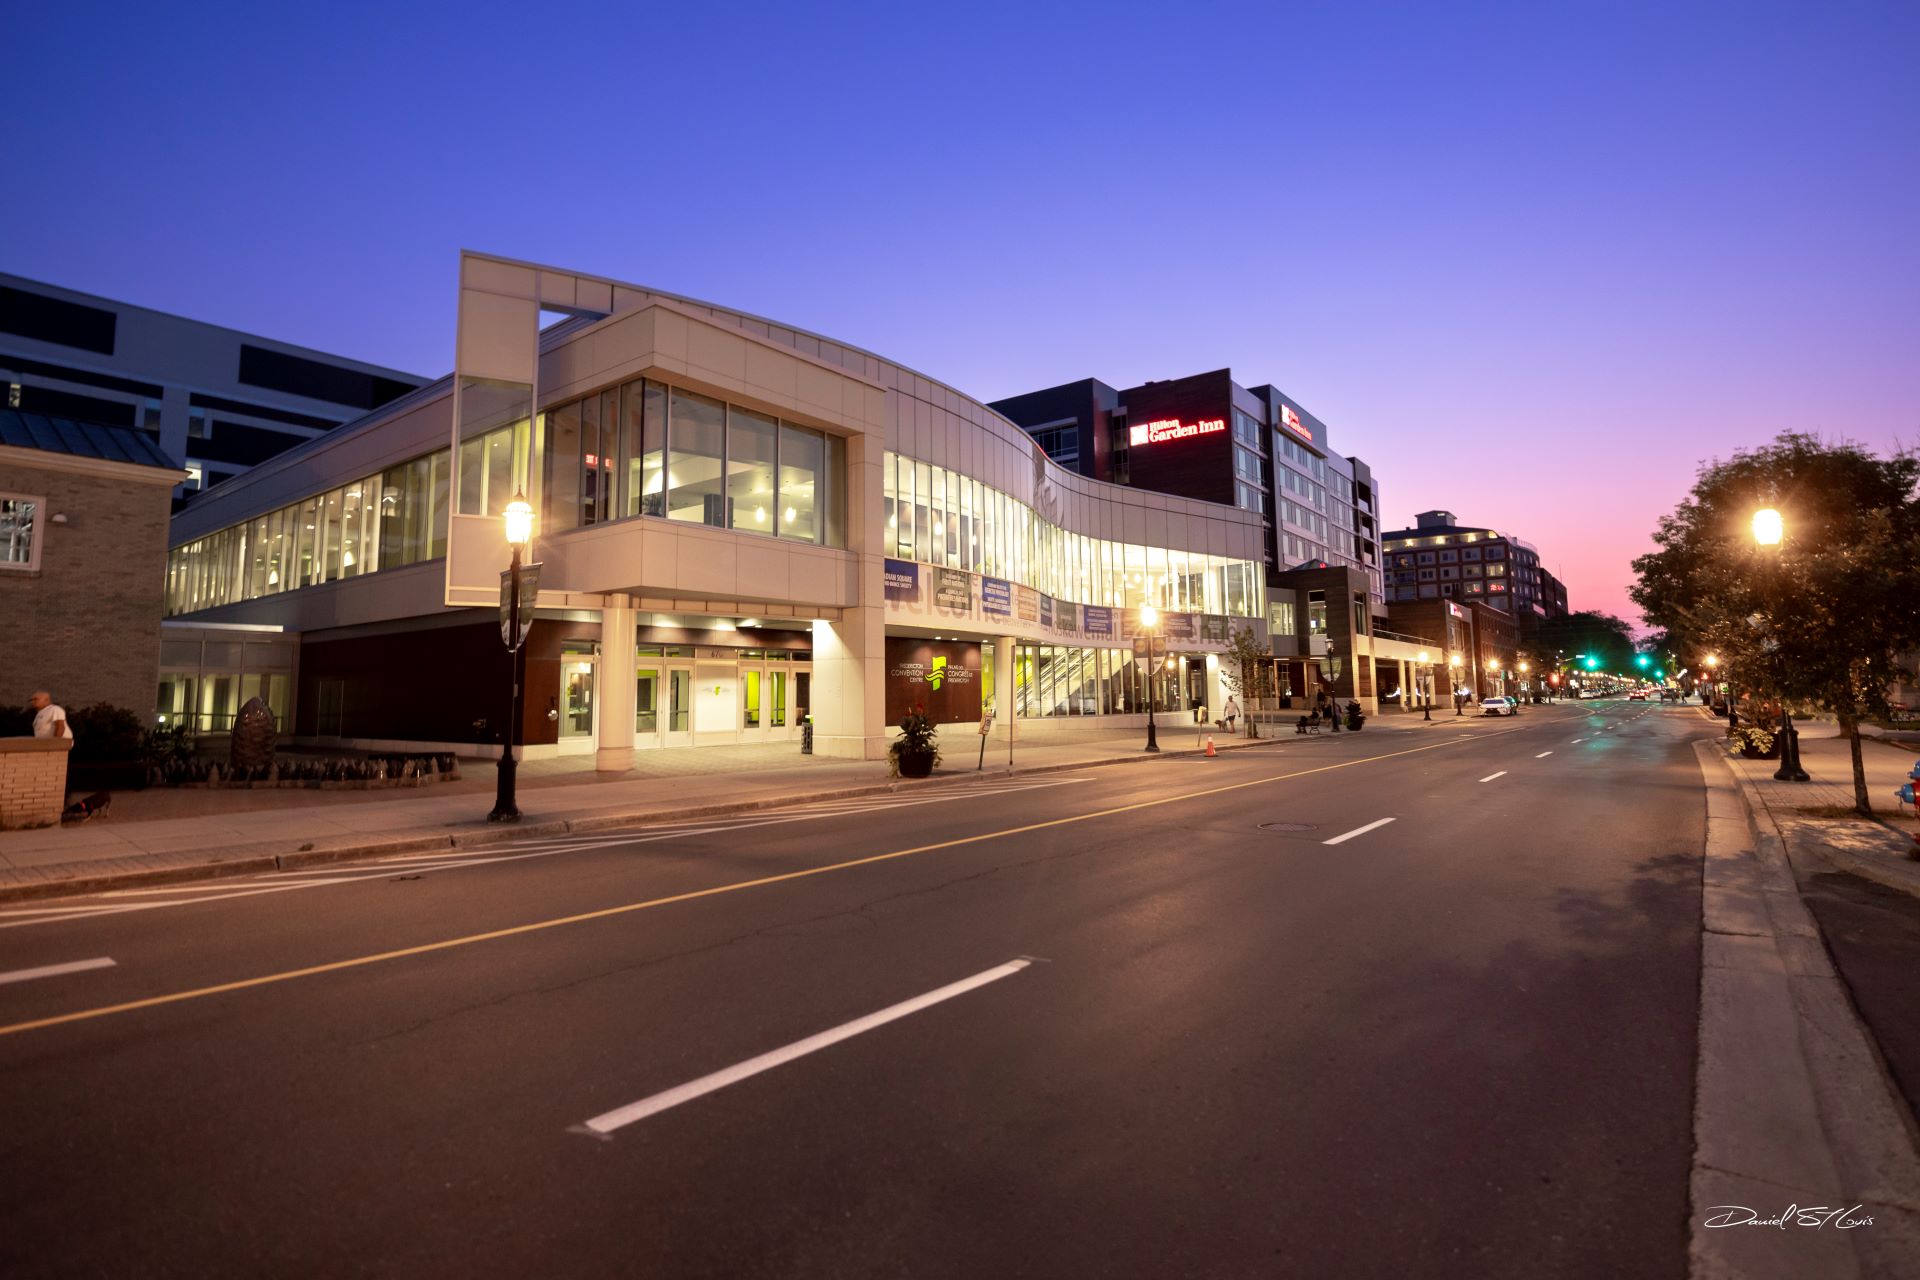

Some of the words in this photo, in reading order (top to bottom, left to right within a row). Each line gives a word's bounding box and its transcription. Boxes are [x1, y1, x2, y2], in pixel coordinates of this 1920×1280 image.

[1149, 419, 1179, 431] Hilton
[1149, 425, 1198, 442] Garden
[1199, 419, 1225, 432] Inn
[891, 669, 923, 677] CONVENTION
